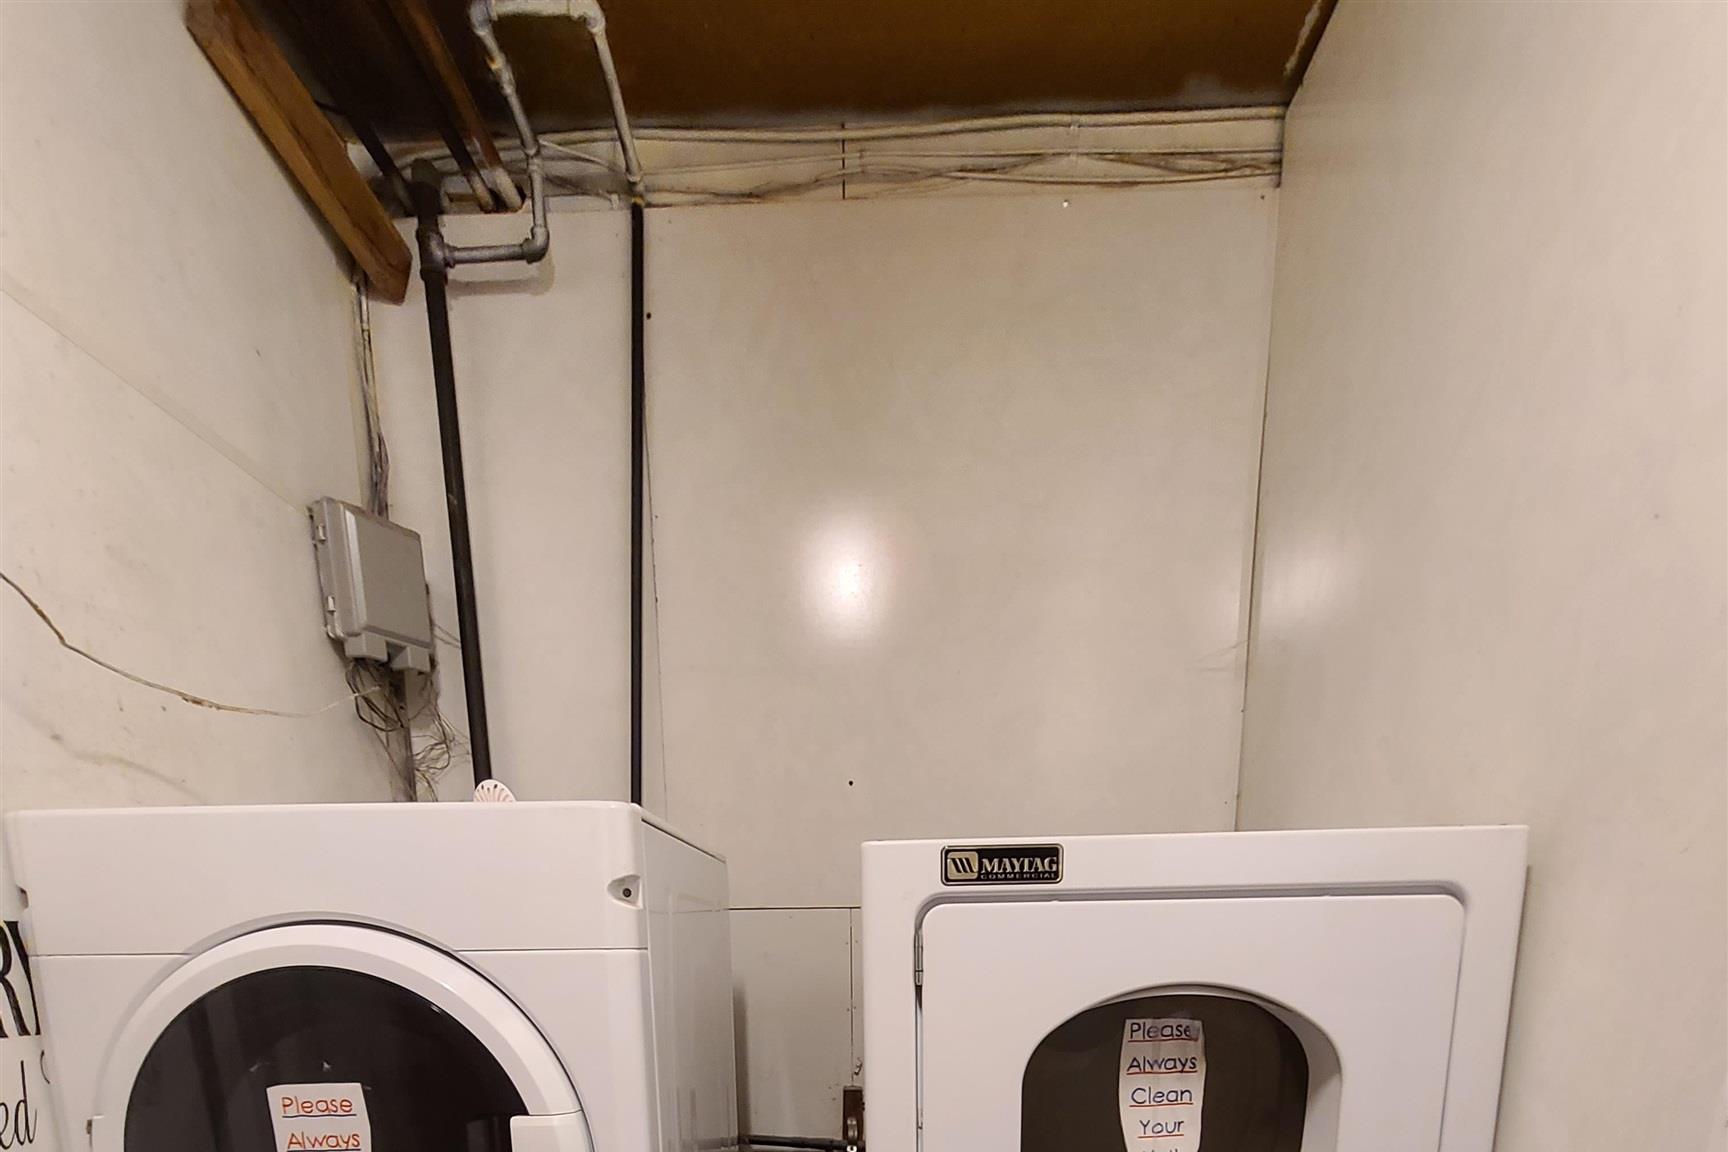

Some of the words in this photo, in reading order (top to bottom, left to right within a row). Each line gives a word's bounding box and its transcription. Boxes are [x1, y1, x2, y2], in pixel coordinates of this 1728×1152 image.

[980, 857, 1058, 873] MAYTAG
[1129, 1022, 1193, 1040] Please
[1127, 1056, 1198, 1073] Always
[1131, 1086, 1193, 1105] Clean
[281, 1096, 353, 1114] Please
[1139, 1119, 1185, 1135] Your
[287, 1131, 361, 1150] Always
